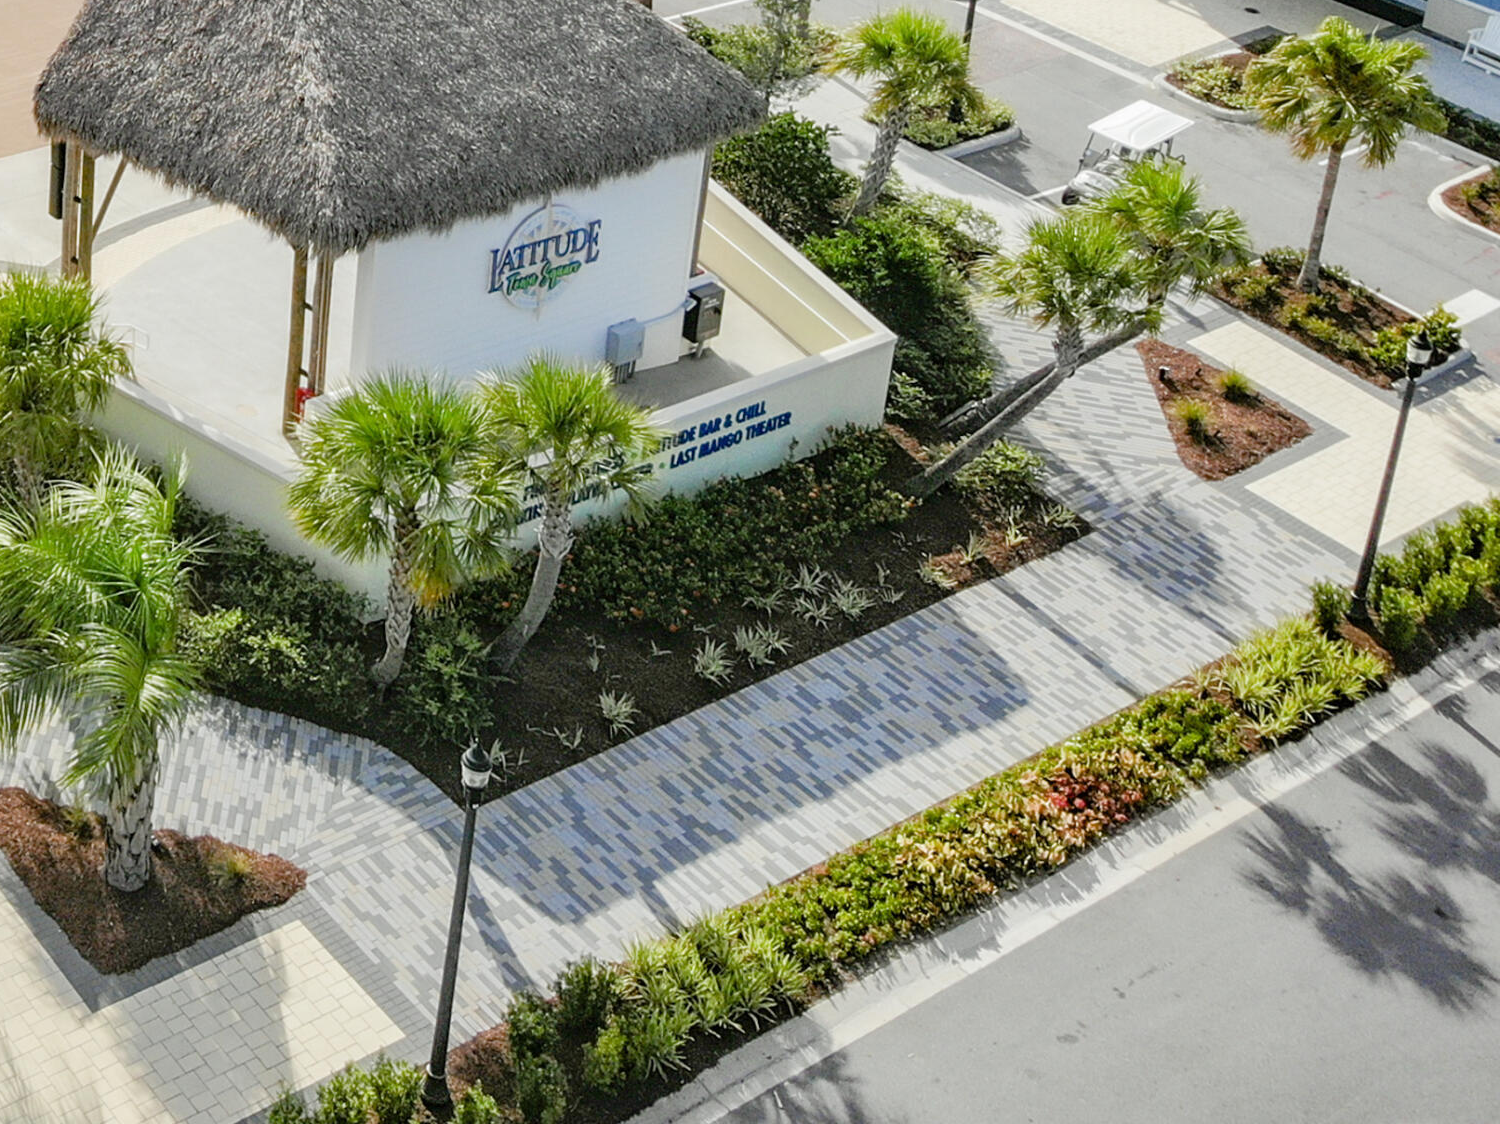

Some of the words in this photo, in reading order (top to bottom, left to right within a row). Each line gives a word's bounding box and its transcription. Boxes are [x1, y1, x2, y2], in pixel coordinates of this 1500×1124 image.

[488, 219, 602, 294] LATITUDE
[670, 446, 698, 469] LAST
[698, 429, 743, 459] MANGO
[745, 411, 792, 440] THEATER
[698, 417, 723, 438] BAR
[723, 414, 733, 428] &
[736, 401, 767, 424] CHILL
